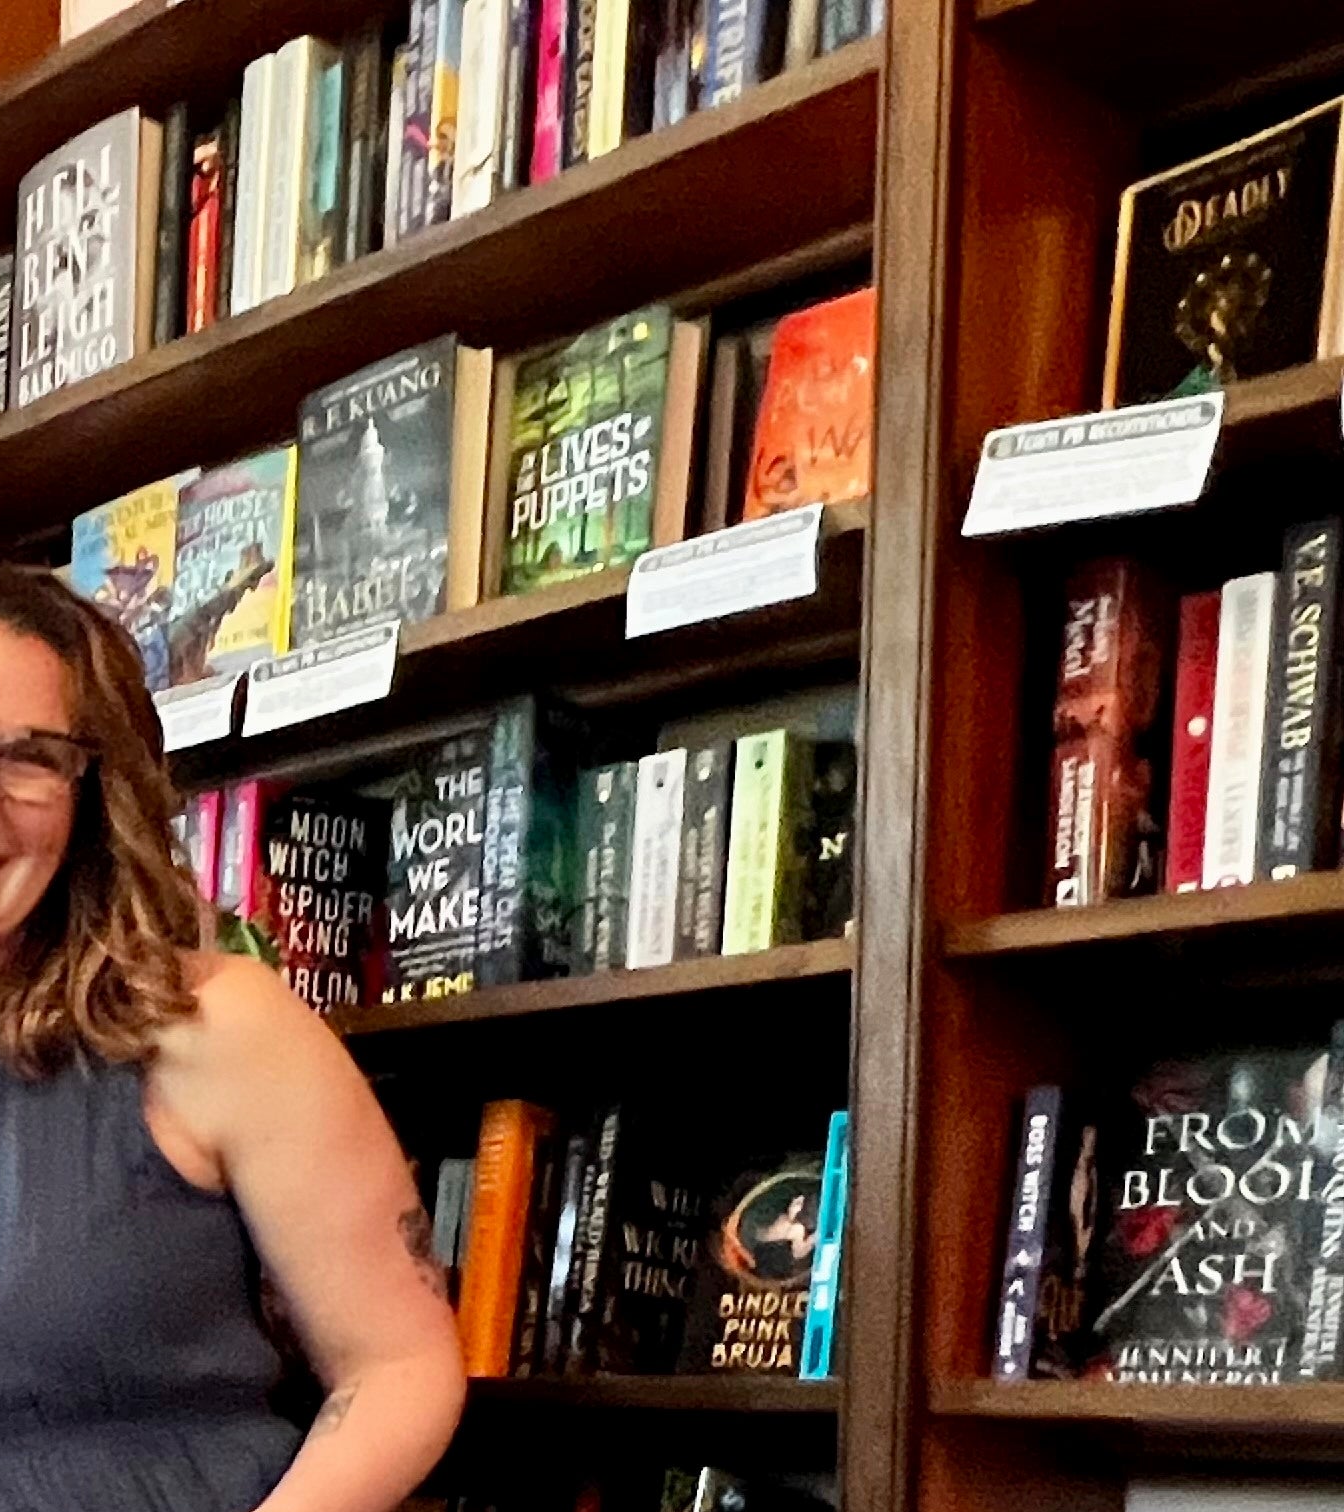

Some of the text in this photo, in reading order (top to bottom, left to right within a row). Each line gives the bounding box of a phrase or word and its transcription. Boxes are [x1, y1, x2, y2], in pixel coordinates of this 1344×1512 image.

[25, 145, 120, 250] HELL
[22, 203, 118, 310] BENT
[20, 278, 115, 368] LEIGH
[18, 335, 118, 409] BARDUGO
[539, 412, 632, 484] LIVES
[511, 449, 653, 540] PUPPETS
[1281, 602, 1322, 751] SCHWAB
[435, 766, 483, 801] THE
[290, 809, 366, 852] MOON
[390, 799, 484, 863] WORL
[268, 840, 349, 882] WITCH
[407, 856, 451, 896] WE
[278, 881, 374, 926] SPIDER
[389, 886, 481, 944] MAKE
[288, 917, 351, 958] KING
[280, 965, 359, 1006] RLON
[1143, 1107, 1324, 1157] FROM
[1120, 1158, 1314, 1211] BLOO
[1194, 1218, 1256, 1242] AND
[1150, 1251, 1279, 1297] ASH
[718, 1291, 809, 1320] BINDLE
[722, 1317, 792, 1343] PUNK
[710, 1342, 796, 1370] BRUJA
